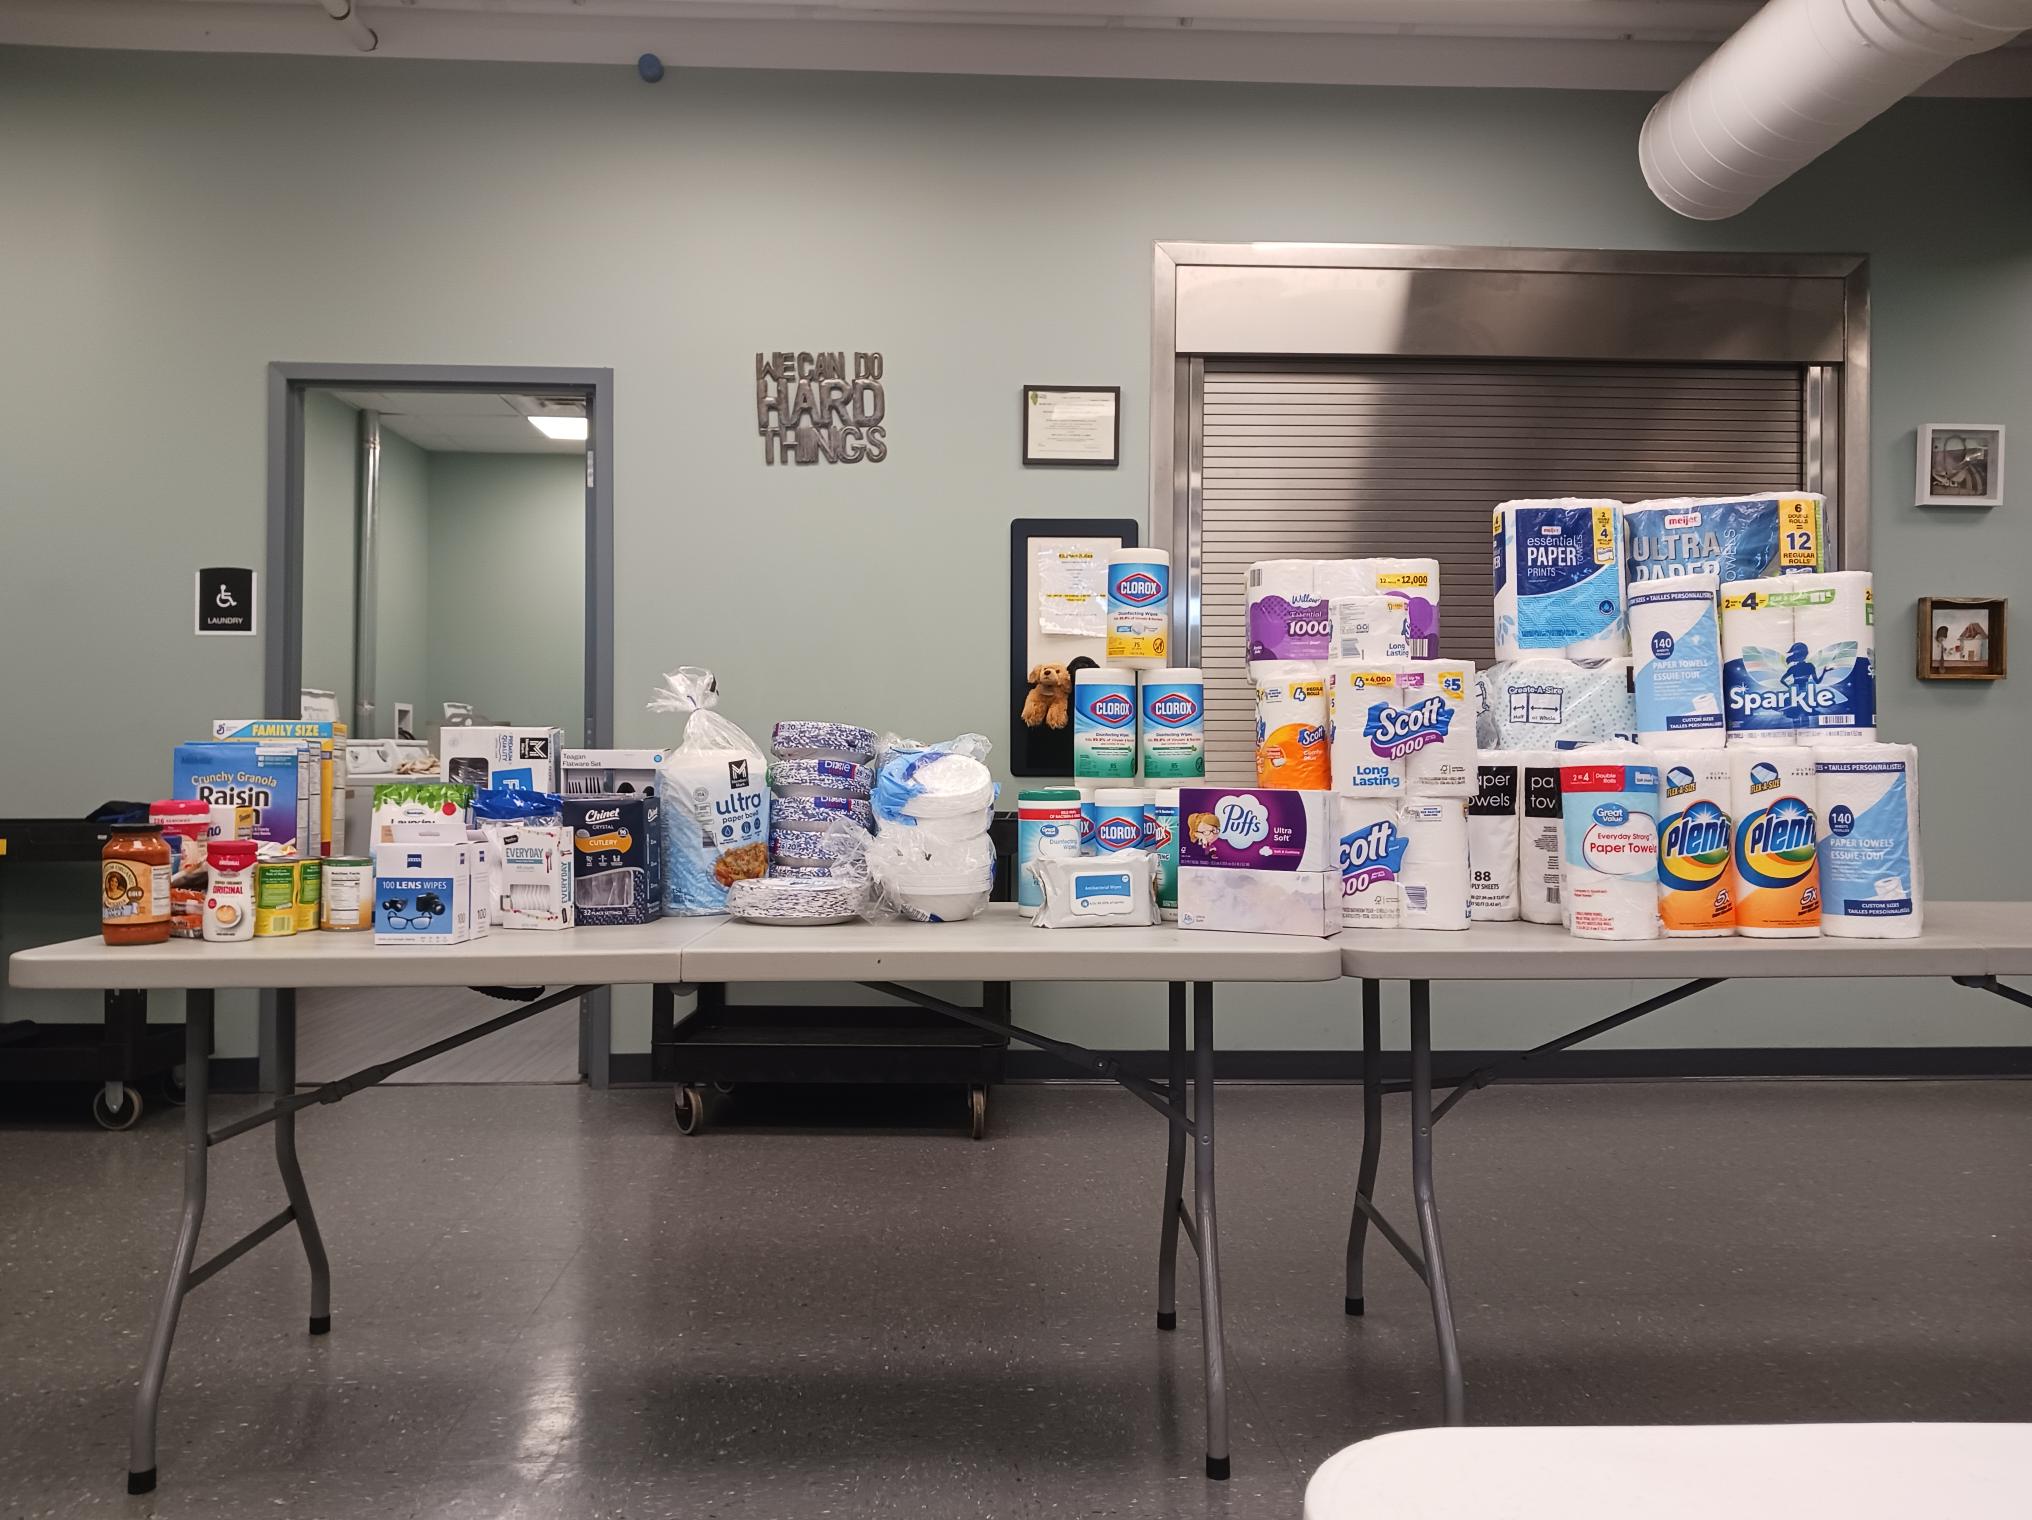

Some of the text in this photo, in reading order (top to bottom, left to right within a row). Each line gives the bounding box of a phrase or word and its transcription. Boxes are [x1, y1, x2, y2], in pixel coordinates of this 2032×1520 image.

[756, 351, 883, 383] WE CAN DO
[757, 379, 885, 430] HARD
[760, 426, 887, 466] THINGS
[1795, 503, 1802, 513] 6
[1669, 516, 1698, 527] meijer
[1600, 528, 1608, 538] 4
[1527, 535, 1577, 547] essential
[1633, 531, 1722, 562] ULTRA
[1786, 532, 1812, 551] 12
[1527, 546, 1577, 567] PAPER
[1725, 528, 1736, 582] OWELS
[1783, 552, 1815, 560] REGULAR
[1527, 567, 1556, 577] PRINTS
[1401, 575, 1428, 585] 12,000
[1120, 581, 1157, 595] CLOROX
[1292, 594, 1322, 604] Willow
[1650, 593, 1670, 601] TAILLES
[1725, 599, 1730, 609] 2
[1742, 592, 1759, 611] 4
[207, 617, 243, 625] LAUNDRY
[1289, 620, 1329, 635] 1000
[1389, 643, 1406, 652] Long
[1654, 638, 1672, 650] 140
[1386, 650, 1409, 658] Lasting
[1652, 660, 1709, 670] PAPER TOWELS
[1354, 676, 1365, 689] 4
[1444, 678, 1461, 691] $5
[1294, 687, 1306, 702] 4
[1730, 682, 1835, 716] Sparkle
[1096, 702, 1130, 715] CLOROX
[1155, 702, 1192, 715] CLOROX
[1376, 697, 1442, 742] Scott
[252, 724, 319, 737] FAMILY SIZE
[1303, 726, 1323, 746] Scott
[1390, 736, 1424, 761] 1000
[824, 760, 850, 772] Dixie
[1356, 765, 1389, 776] Long
[191, 771, 277, 788] Crunchy Granola
[1353, 775, 1400, 788] Lasting
[1478, 774, 1511, 790] per
[1583, 772, 1589, 781] 4
[1667, 782, 1697, 798] FLEX-A-SIZE
[1750, 778, 1781, 795] FLEX-A-SIZE
[200, 786, 269, 807] Raisin
[1468, 792, 1510, 807] owels
[716, 792, 762, 815] ultra
[585, 807, 620, 822] Chinet
[1597, 808, 1623, 817] Great
[1831, 813, 1851, 824] 140
[722, 814, 744, 825] paper
[1222, 804, 1261, 837] Puffs
[1100, 827, 1137, 840] CLOROX
[1273, 827, 1292, 835] Ultra
[1597, 832, 1631, 841] Everyday
[1666, 815, 1731, 857] Plenty
[1273, 834, 1290, 842] Soft
[1830, 838, 1894, 848] PAPER TOWELS
[1339, 822, 1393, 869] cott
[1590, 843, 1626, 855] Paper
[506, 847, 544, 858] EVERYDAY
[560, 862, 568, 904] EVERYDAY
[1474, 871, 1491, 882] 88
[213, 885, 243, 895] ORIGINAL
[382, 881, 447, 889] 100 LENS WIPES
[1341, 873, 1369, 896] 00
